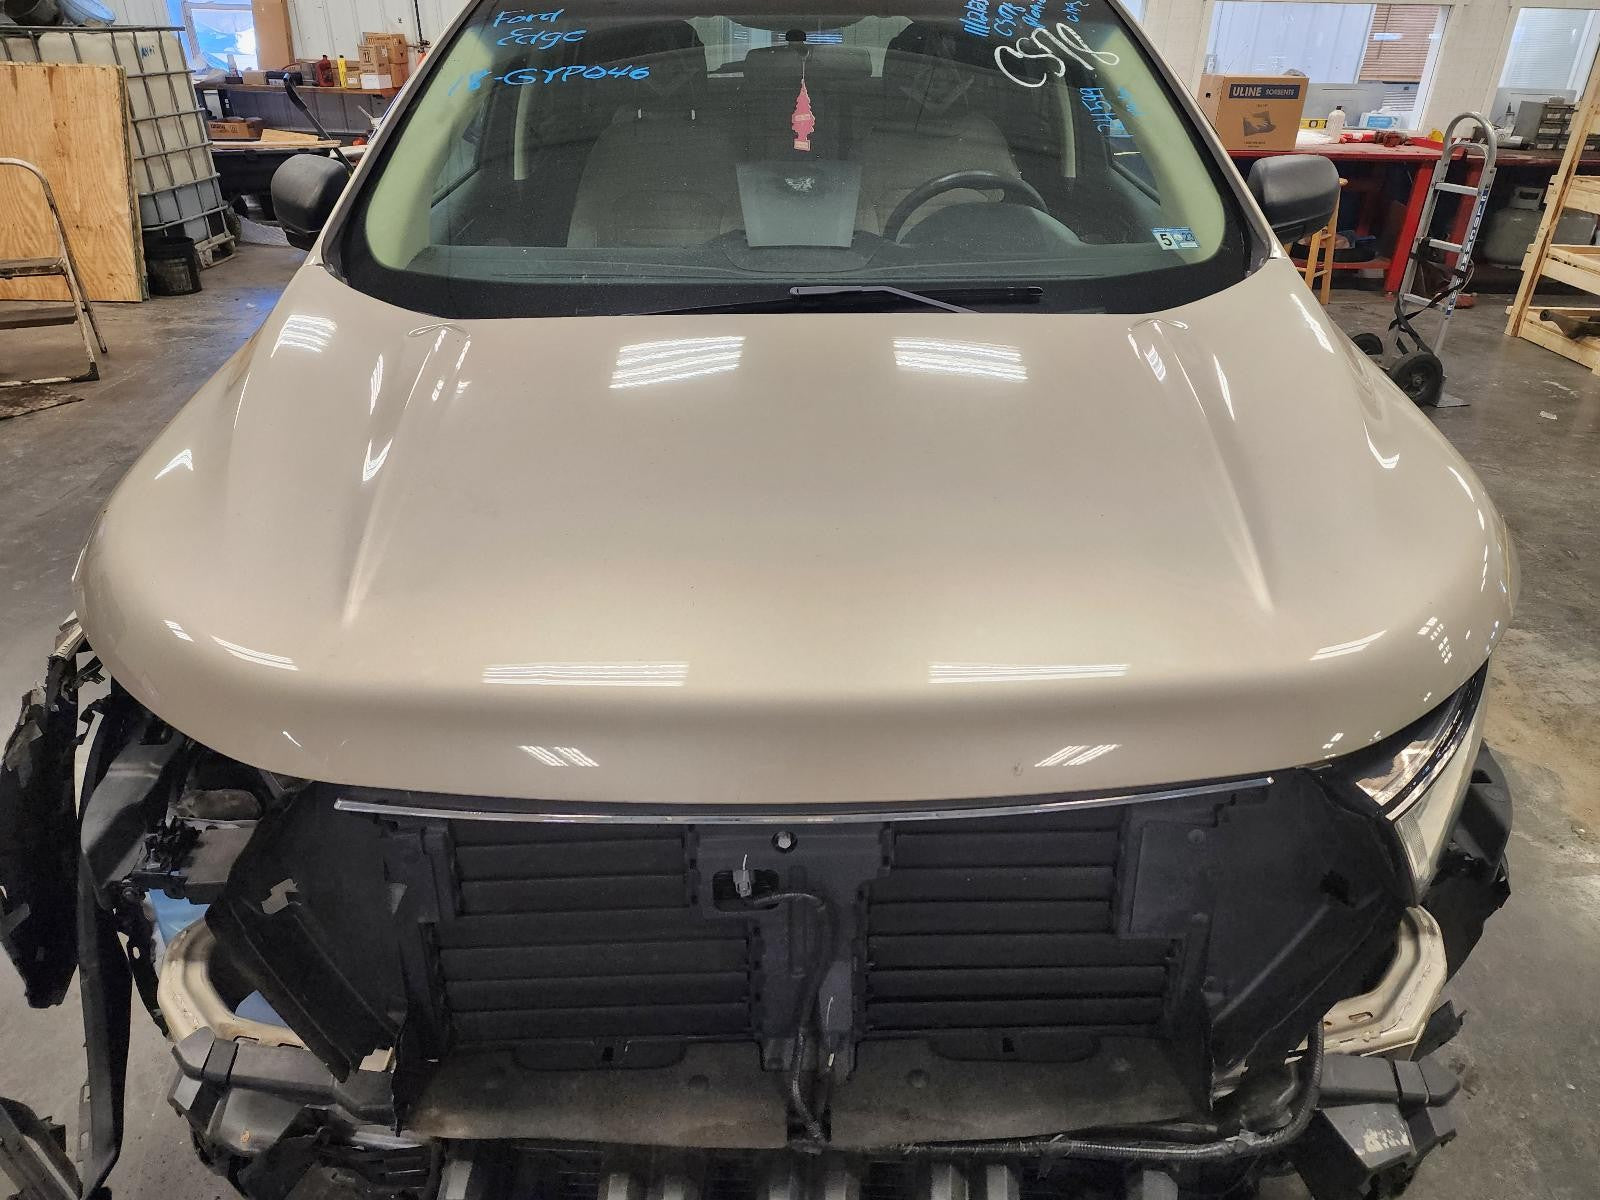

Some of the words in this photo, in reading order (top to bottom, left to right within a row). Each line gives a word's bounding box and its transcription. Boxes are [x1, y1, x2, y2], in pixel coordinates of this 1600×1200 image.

[493, 8, 564, 28] Ford
[496, 27, 588, 50] Edge
[1232, 86, 1262, 97] ULINE
[1159, 233, 1173, 247] 5
